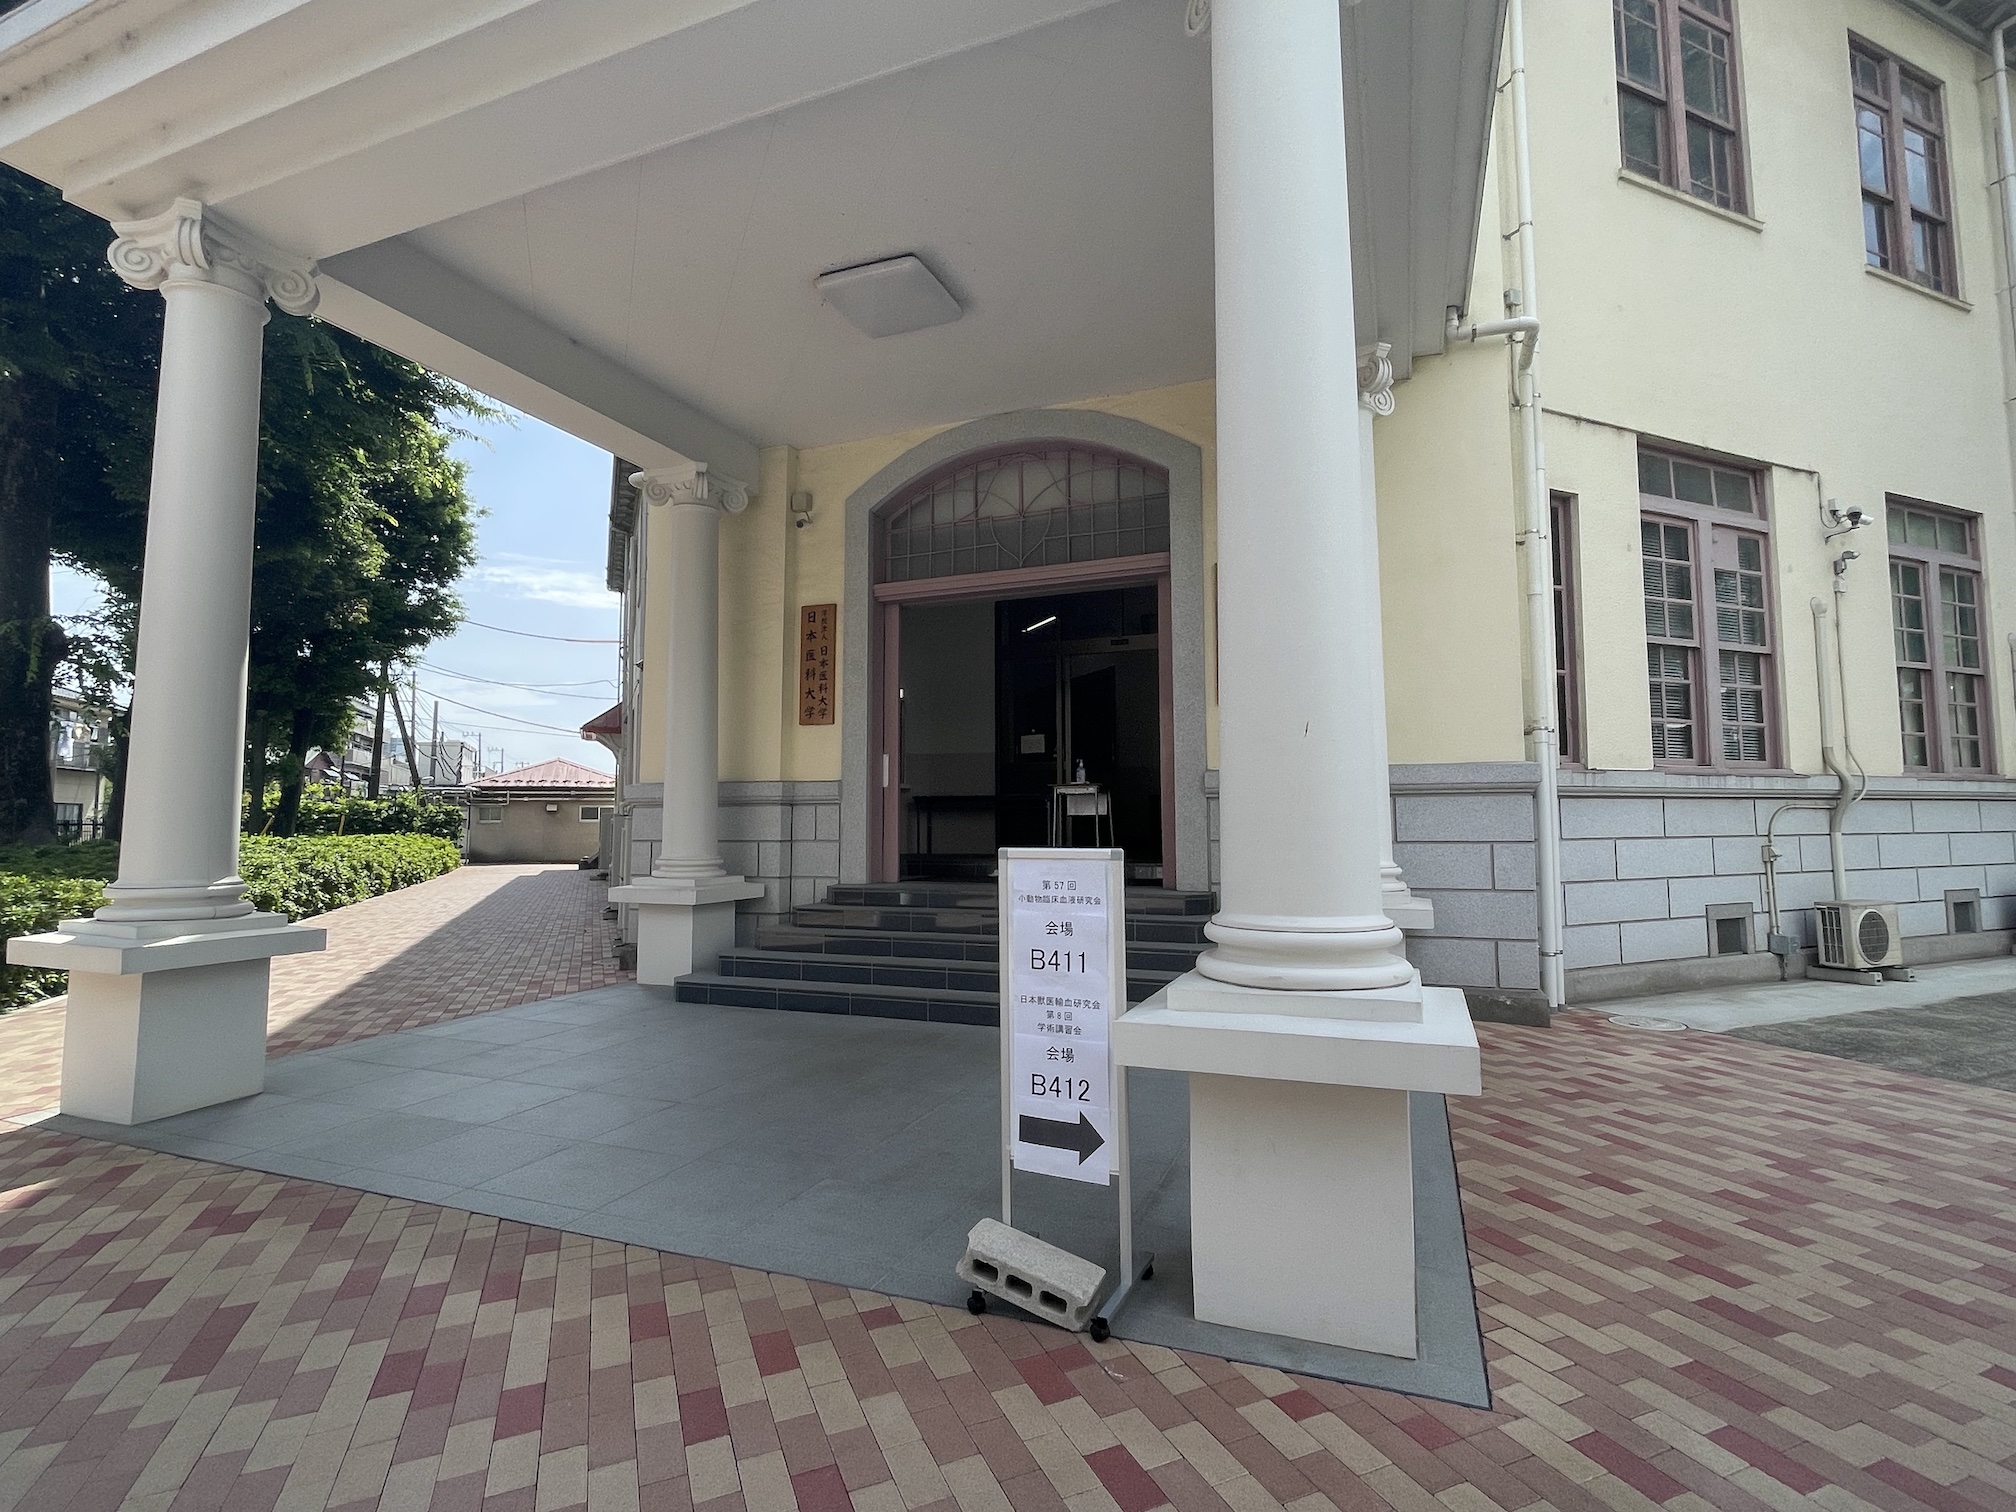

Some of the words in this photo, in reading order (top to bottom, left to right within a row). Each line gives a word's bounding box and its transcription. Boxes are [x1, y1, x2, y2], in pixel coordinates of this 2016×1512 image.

[804, 611, 817, 719] 日本医科大学
[1018, 894, 1101, 905] 小動物臨床血液研究会
[1045, 920, 1074, 937] 会場
[1031, 948, 1085, 974] B411
[1020, 995, 1101, 1010] 日本獣医輸血研究会
[1037, 1023, 1082, 1036] 学術講習会
[1046, 1046, 1075, 1063] 会場
[1031, 1073, 1091, 1102] B412
